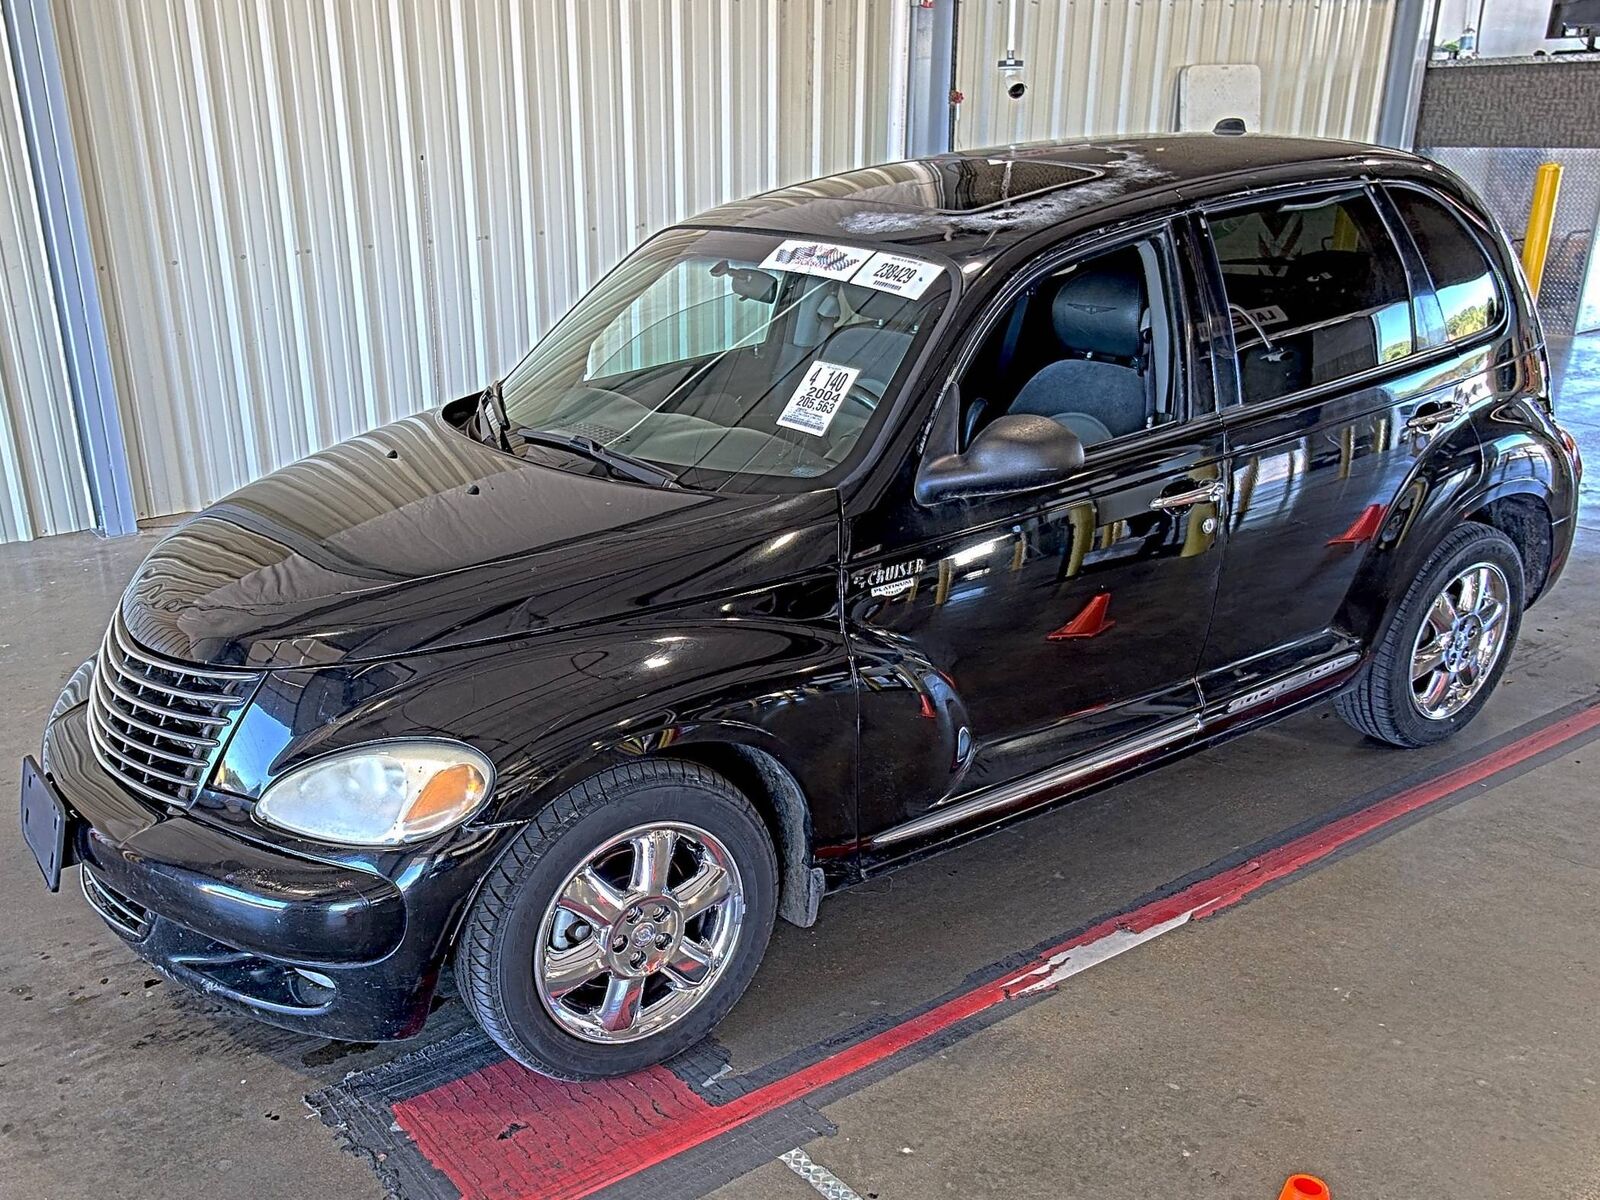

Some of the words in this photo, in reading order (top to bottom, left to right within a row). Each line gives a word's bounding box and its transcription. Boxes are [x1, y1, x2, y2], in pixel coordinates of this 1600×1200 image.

[873, 263, 917, 283] 238429
[809, 367, 822, 386] 4
[823, 370, 849, 392] 140
[806, 386, 841, 403] 2004
[867, 558, 924, 586] CRUISER
[873, 580, 912, 594] PLATINUM
